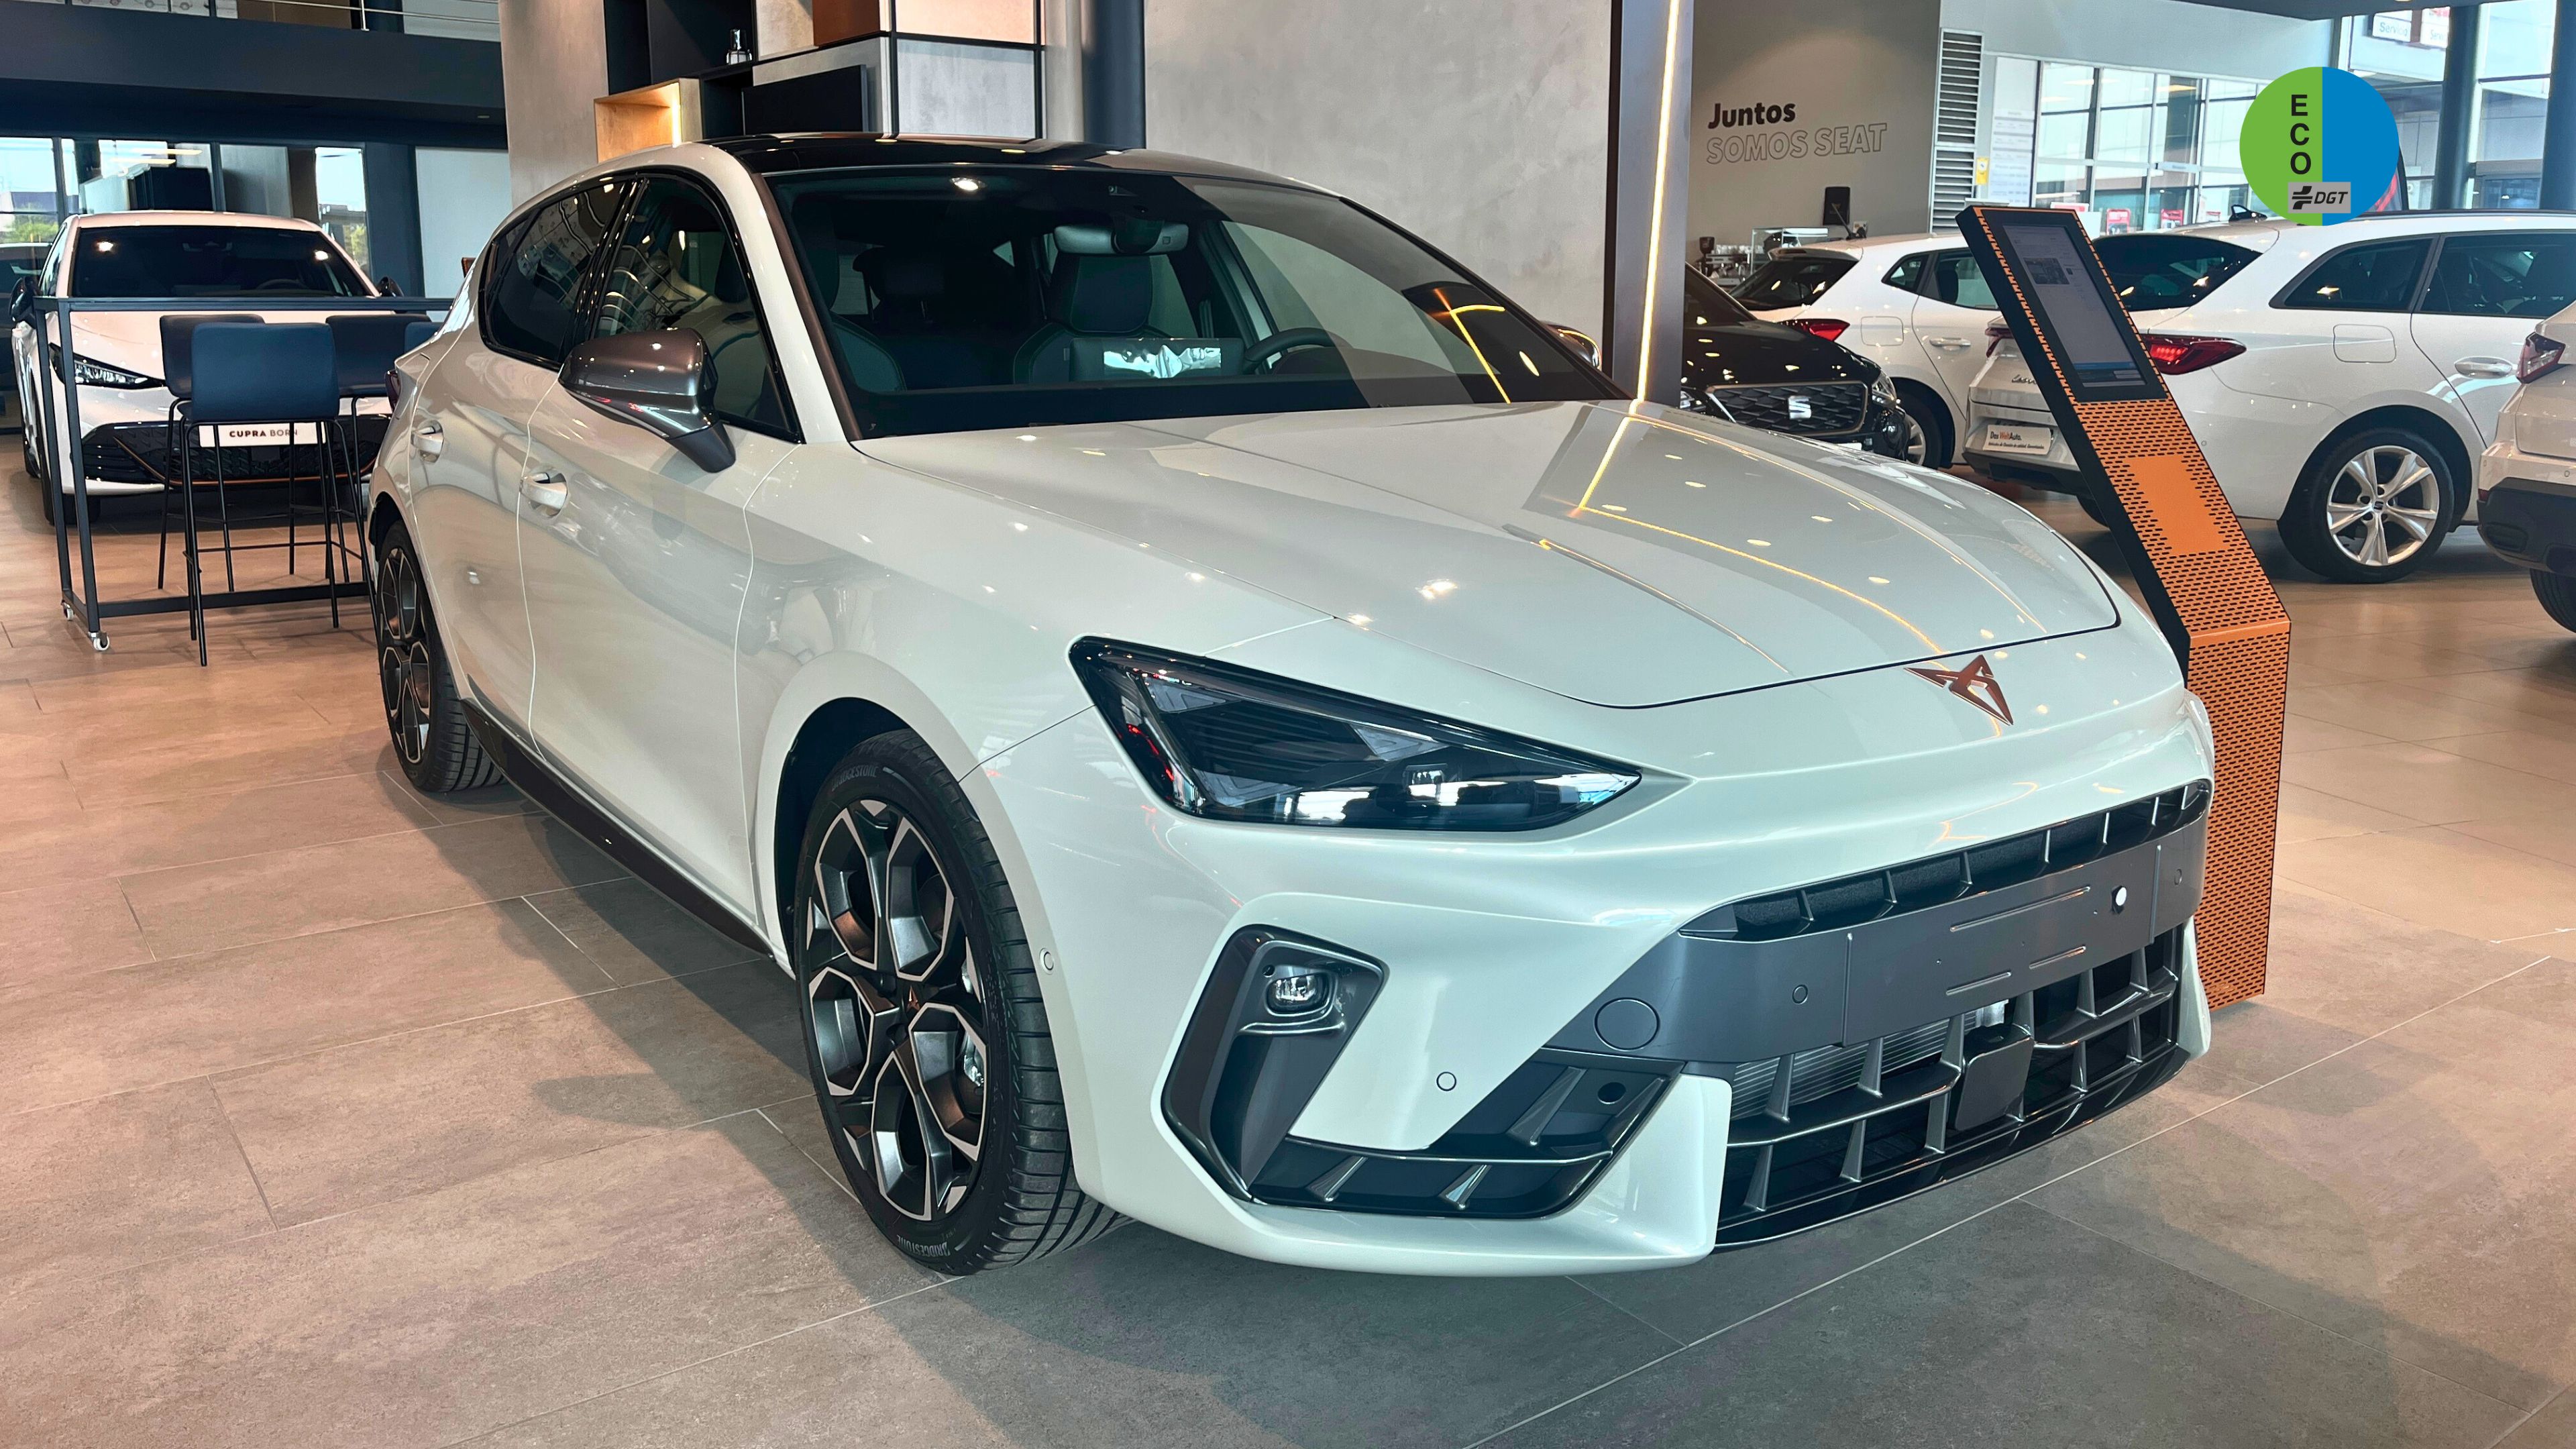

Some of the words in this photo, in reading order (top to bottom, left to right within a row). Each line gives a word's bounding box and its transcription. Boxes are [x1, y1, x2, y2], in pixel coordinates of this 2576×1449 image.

[1708, 103, 1796, 129] Juntos
[1707, 129, 1809, 164] SOMOS
[1814, 123, 1887, 157] SEAT
